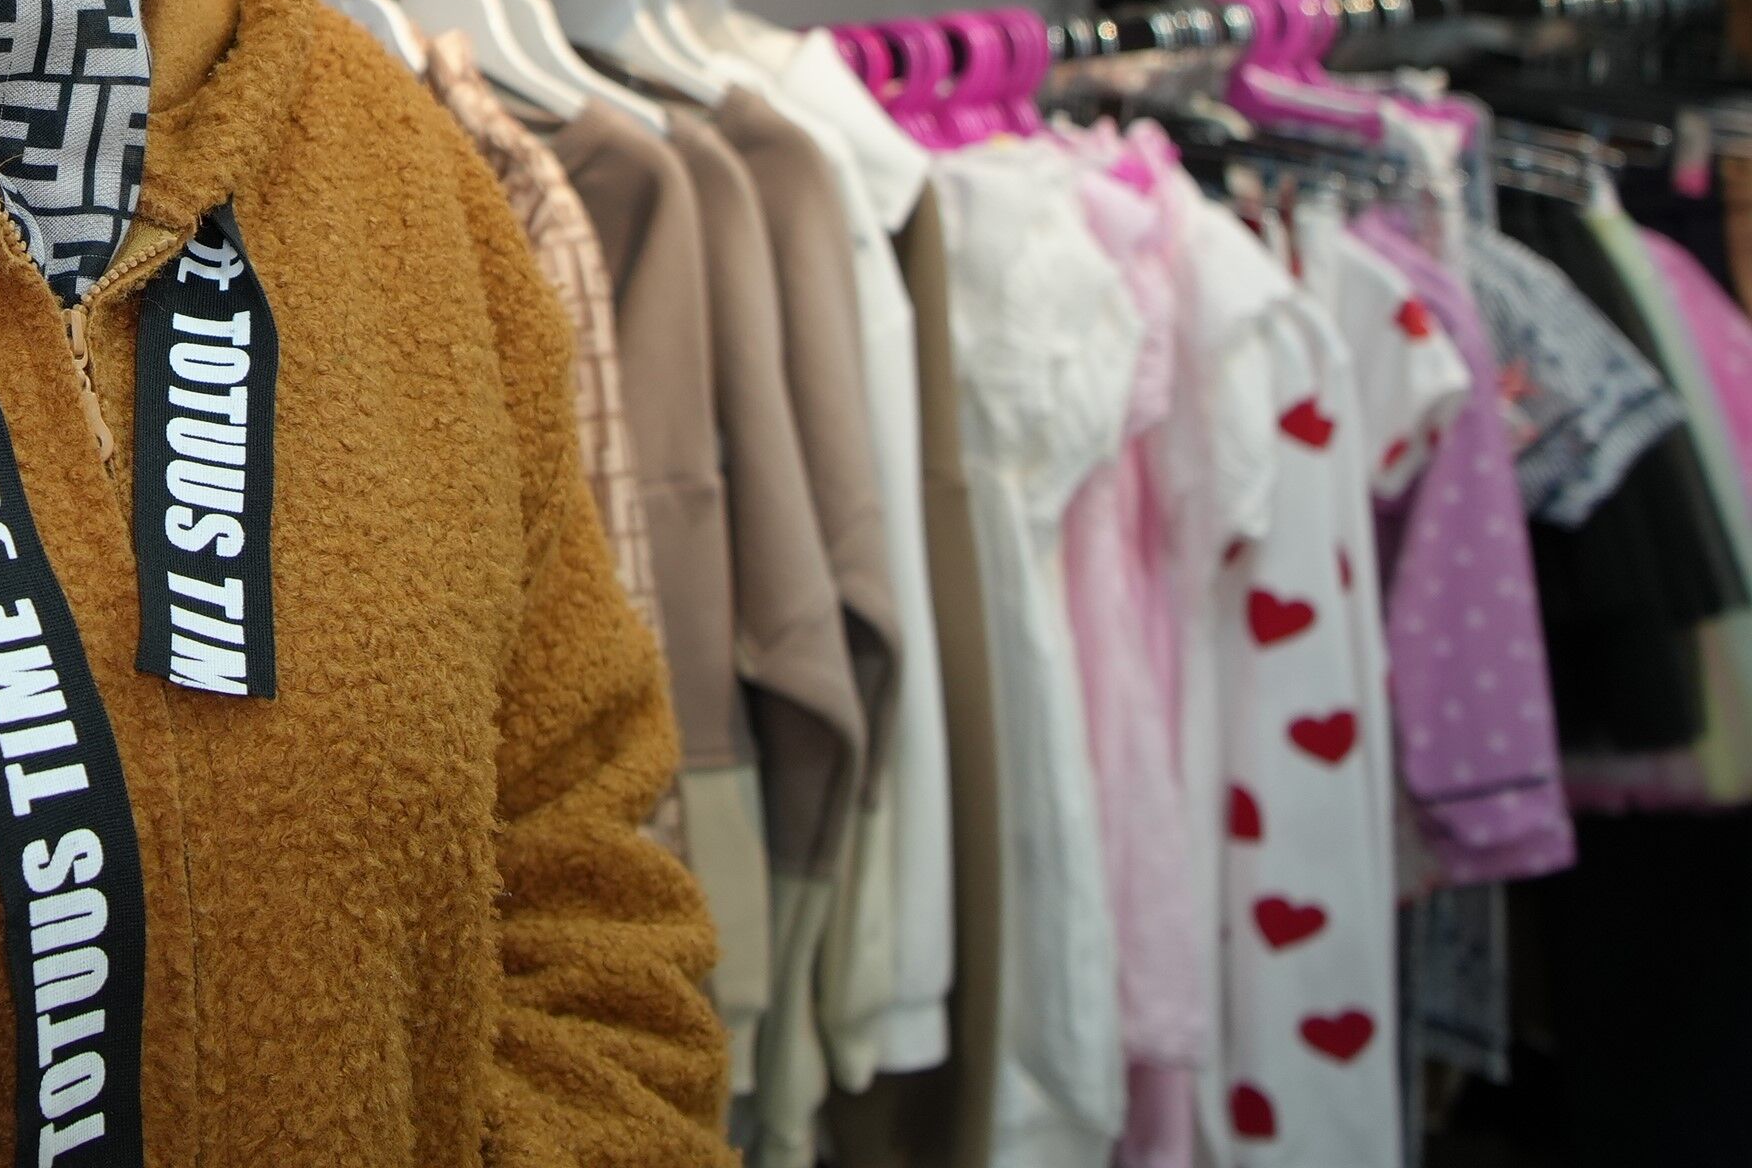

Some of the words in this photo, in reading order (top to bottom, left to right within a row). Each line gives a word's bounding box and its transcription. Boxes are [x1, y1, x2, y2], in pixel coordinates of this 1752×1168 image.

[164, 310, 251, 558] TOTUUS
[167, 570, 248, 696] TIM
[22, 828, 108, 1168] TOTUUS
